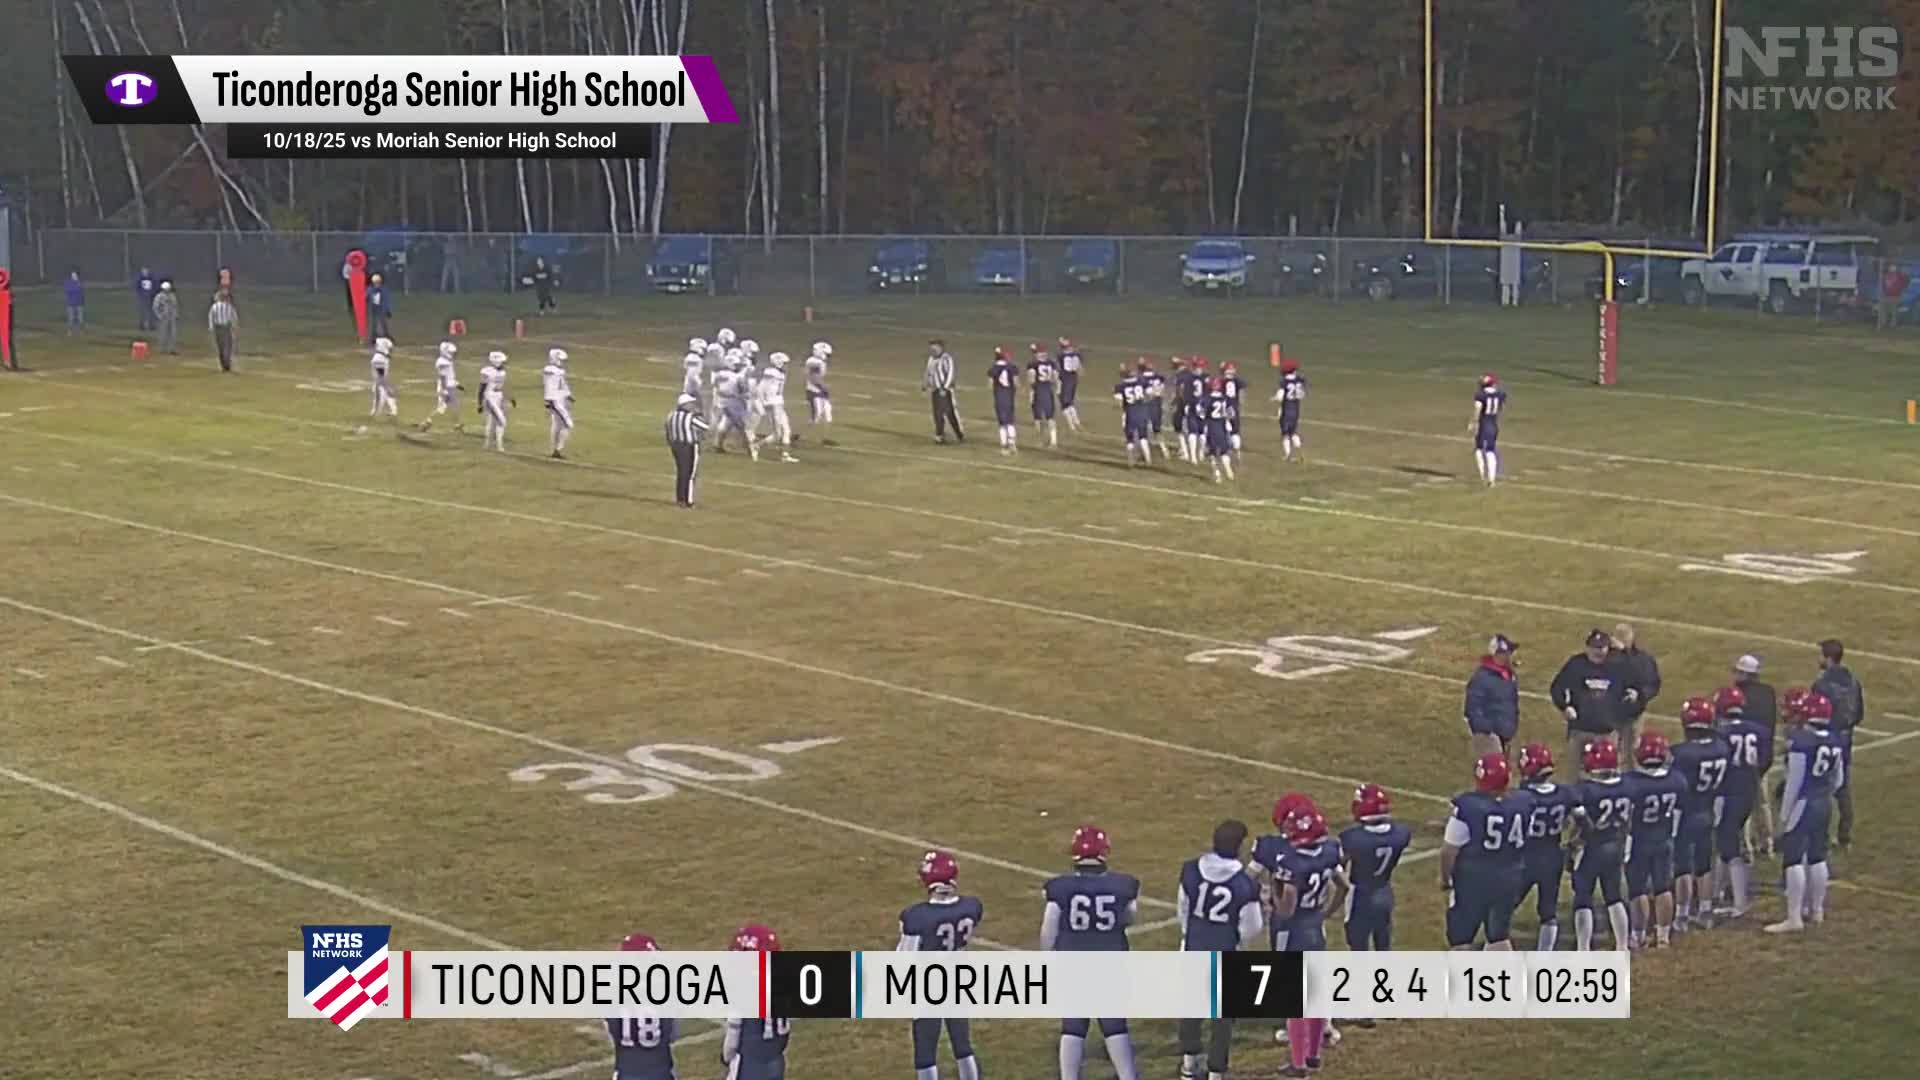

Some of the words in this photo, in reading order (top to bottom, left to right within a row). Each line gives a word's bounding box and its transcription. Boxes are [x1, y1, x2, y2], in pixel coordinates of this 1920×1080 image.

[999, 369, 1009, 387] 4
[1485, 397, 1499, 415] 11
[1187, 634, 1413, 679] 20
[1730, 733, 1758, 766] 76
[508, 742, 782, 804] 30
[1697, 758, 1727, 792] 57
[1643, 792, 1678, 823] 27
[1483, 813, 1525, 850] 54
[1373, 846, 1393, 877] 7
[1069, 895, 1116, 931] 65
[1193, 882, 1234, 923] 12
[936, 918, 974, 951] 33
